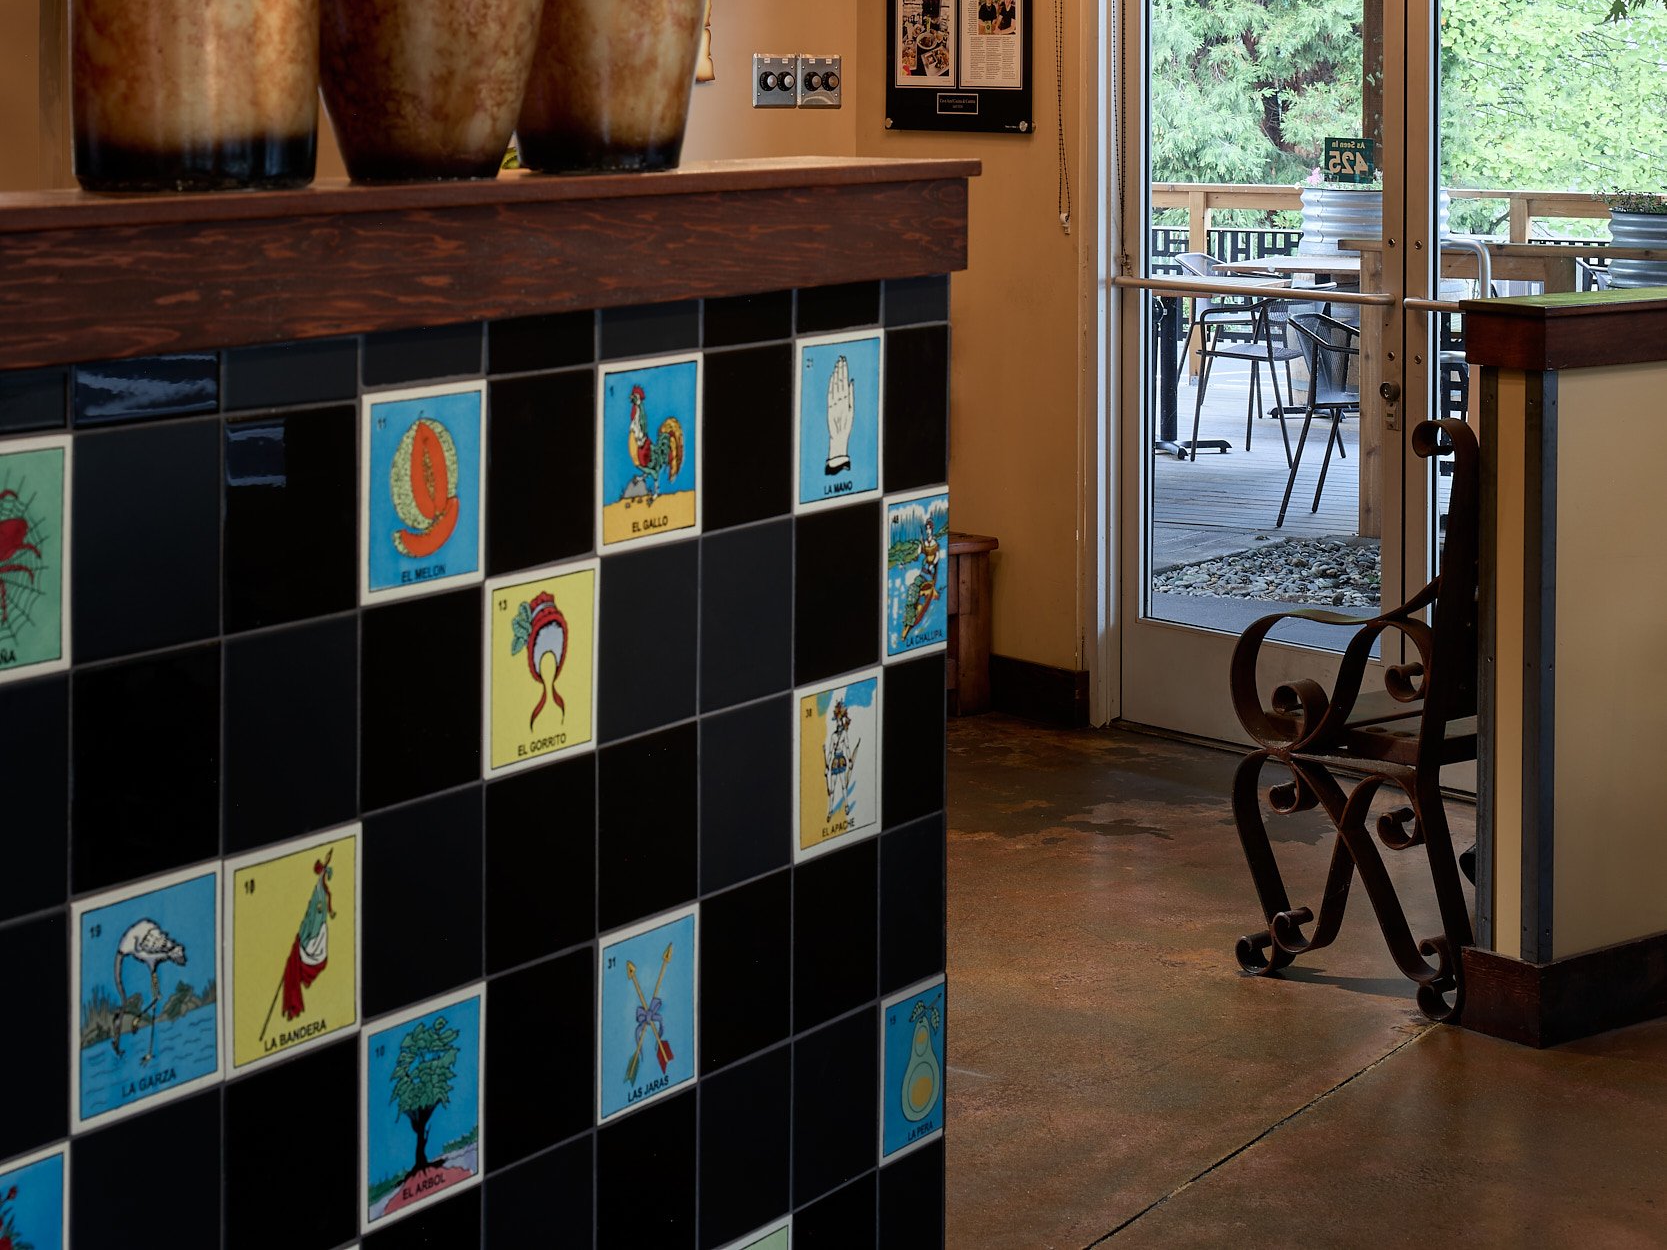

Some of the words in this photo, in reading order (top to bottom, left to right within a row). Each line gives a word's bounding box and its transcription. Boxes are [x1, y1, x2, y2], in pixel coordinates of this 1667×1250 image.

[824, 484, 832, 495] LA
[834, 480, 853, 493] MANO
[632, 521, 641, 533] EL
[643, 515, 669, 531] GALLO
[401, 570, 412, 584] EL
[415, 564, 446, 581] MELON
[498, 599, 507, 612] 13
[906, 636, 914, 647] LA
[518, 744, 528, 756] EL
[530, 733, 567, 752] GORRITO
[822, 825, 829, 838] EL
[831, 817, 855, 834] APACHE
[607, 957, 617, 969] 31
[264, 1035, 278, 1053] LA
[279, 1019, 328, 1048] BANDERA
[122, 1081, 135, 1098] LA
[139, 1068, 177, 1092] GARZA
[627, 1085, 644, 1103] LAS
[644, 1075, 669, 1097] JARAS
[907, 1128, 917, 1141] LA
[917, 1120, 933, 1136] PERA
[403, 1185, 415, 1201] EL
[415, 1173, 446, 1195] ARBOL
